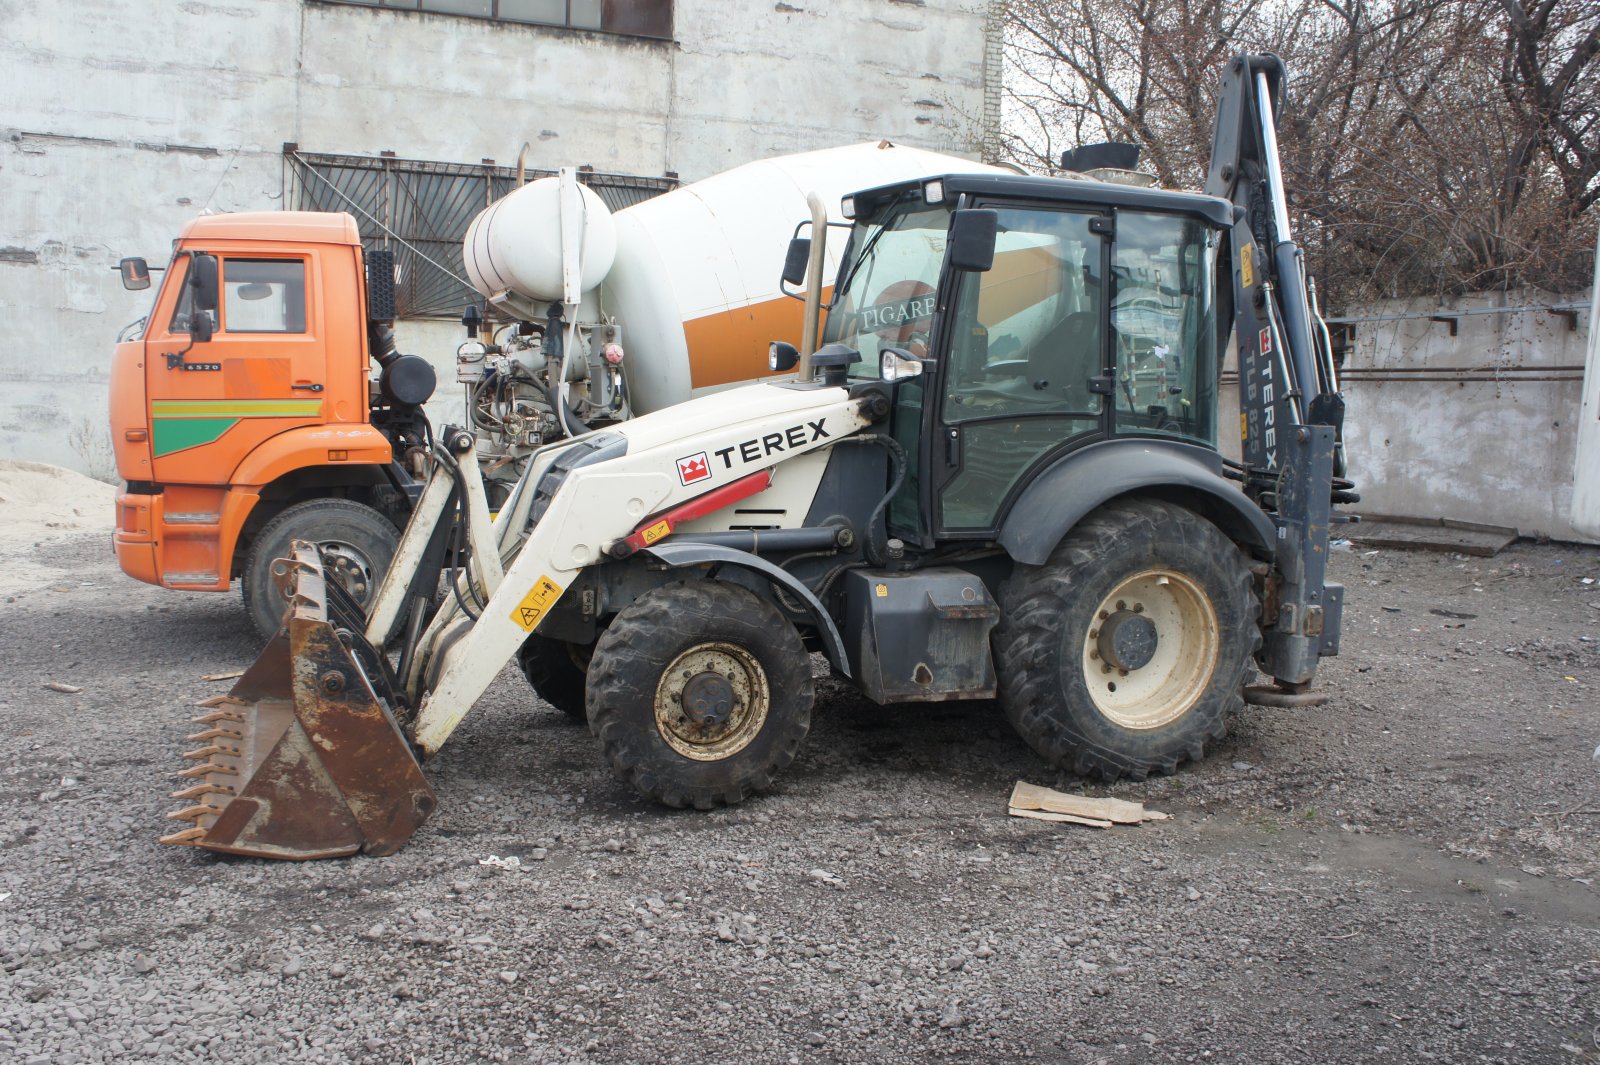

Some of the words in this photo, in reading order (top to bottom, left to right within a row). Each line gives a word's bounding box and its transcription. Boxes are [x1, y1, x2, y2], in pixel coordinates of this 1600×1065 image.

[1245, 349, 1257, 401] TLB
[1248, 409, 1260, 454] 825
[1262, 359, 1277, 471] TEREX
[714, 417, 831, 469] TEREX
